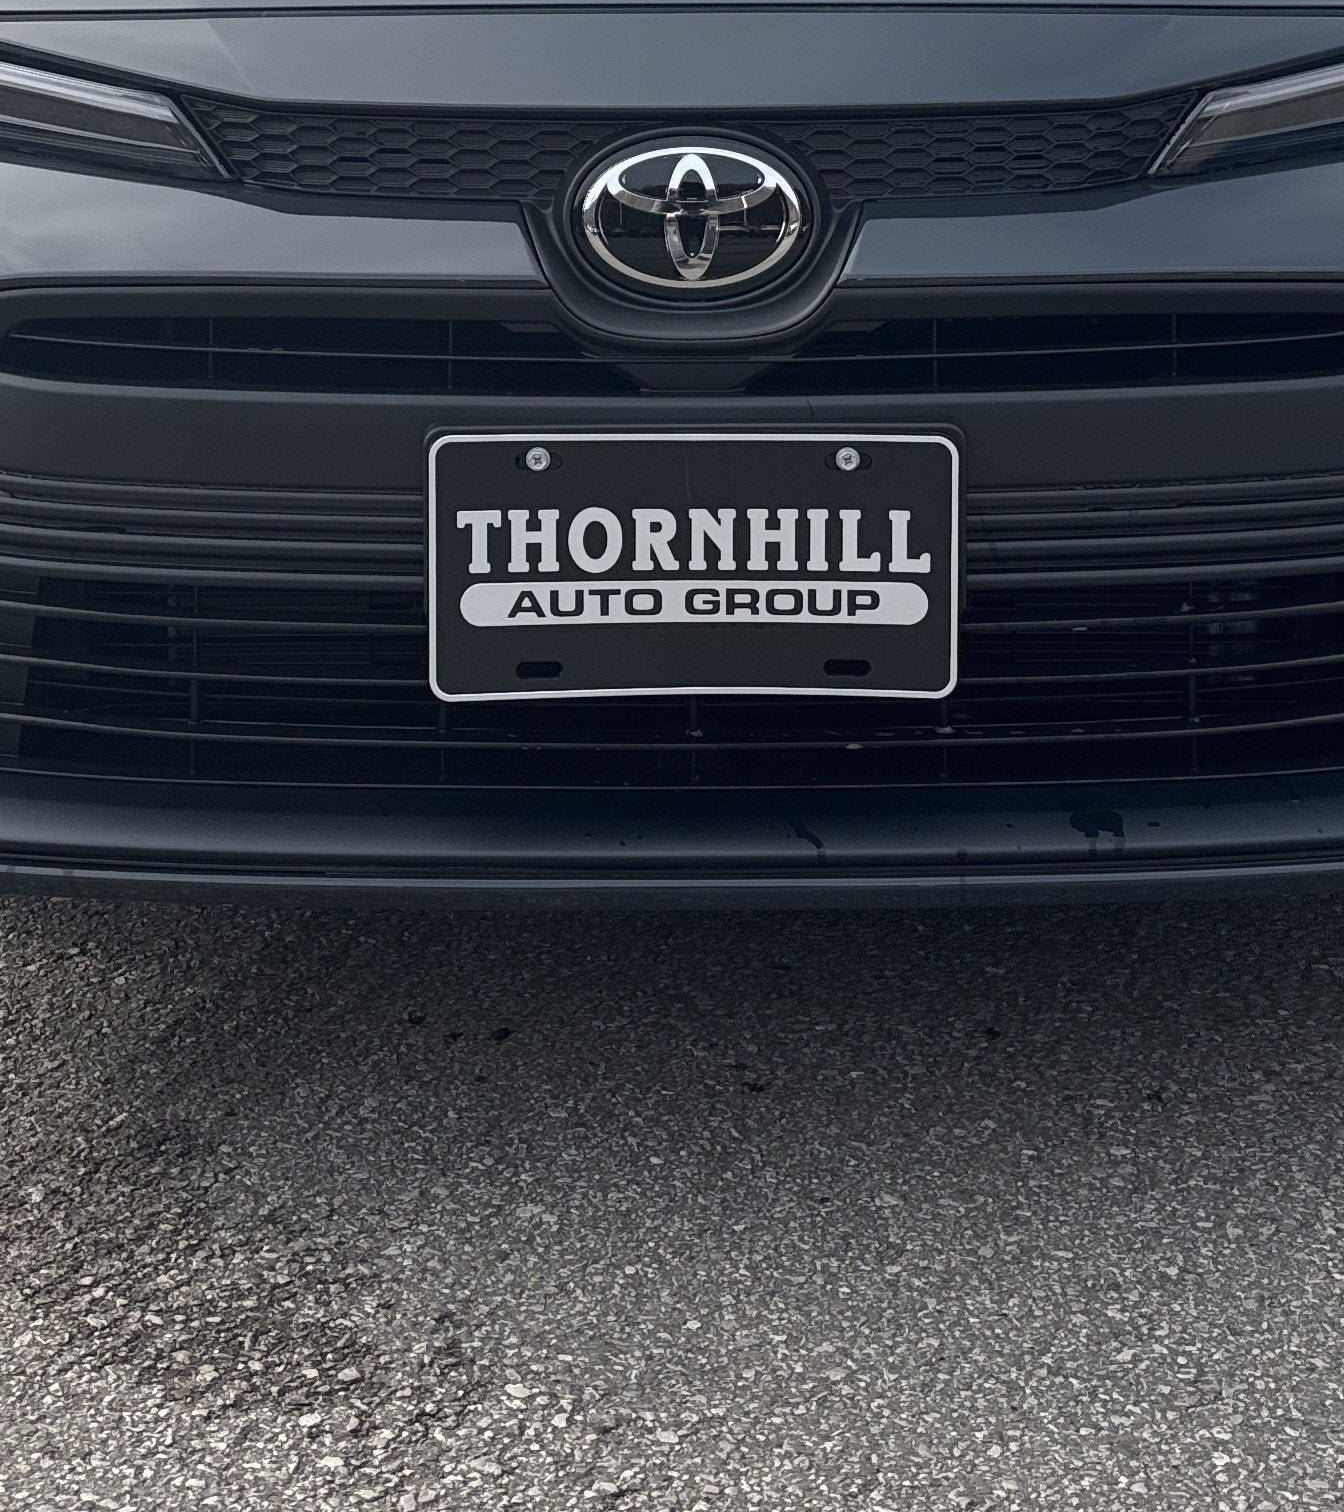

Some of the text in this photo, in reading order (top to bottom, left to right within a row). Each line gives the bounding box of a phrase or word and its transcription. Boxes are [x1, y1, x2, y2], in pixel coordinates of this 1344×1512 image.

[456, 506, 931, 575] THORNHILL
[506, 588, 881, 618] AUTO GROUP
